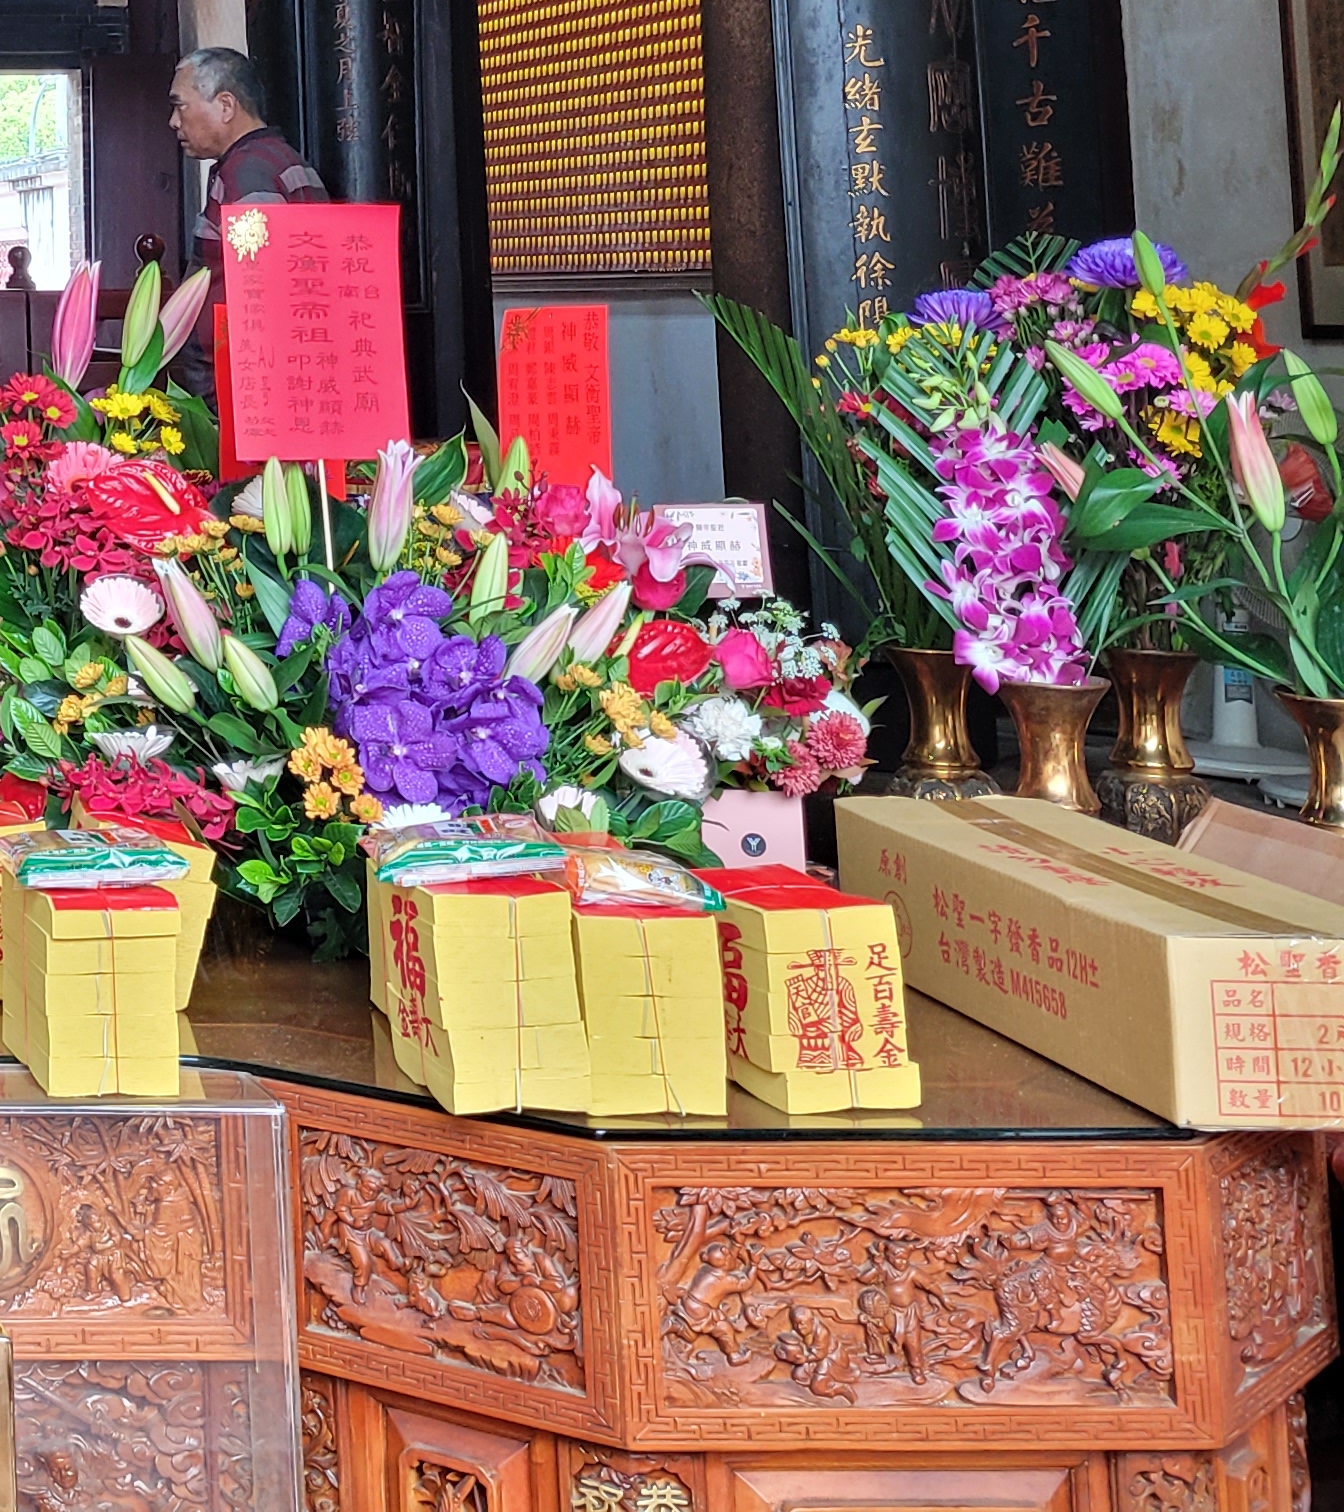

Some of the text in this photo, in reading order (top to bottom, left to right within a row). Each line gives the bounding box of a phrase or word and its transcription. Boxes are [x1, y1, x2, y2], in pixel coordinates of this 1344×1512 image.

[286, 231, 335, 343] 文衡聖帝祖
[286, 354, 315, 434] 叩謝神恩
[561, 321, 581, 435] 神威顯赫
[583, 311, 602, 446] 恭敬 文衡聖帝
[687, 540, 742, 552] 神威顯赫
[878, 848, 908, 885] 原創
[389, 894, 427, 1004] 福
[937, 931, 1068, 1020] 台灣製造 M415658
[1236, 949, 1343, 980] 松聖香
[864, 943, 908, 1068] 足百壽金
[1222, 989, 1264, 1008] 品名
[1223, 1022, 1271, 1043] 規格
[1225, 1055, 1271, 1076] 時間
[1227, 1088, 1273, 1110] 數量
